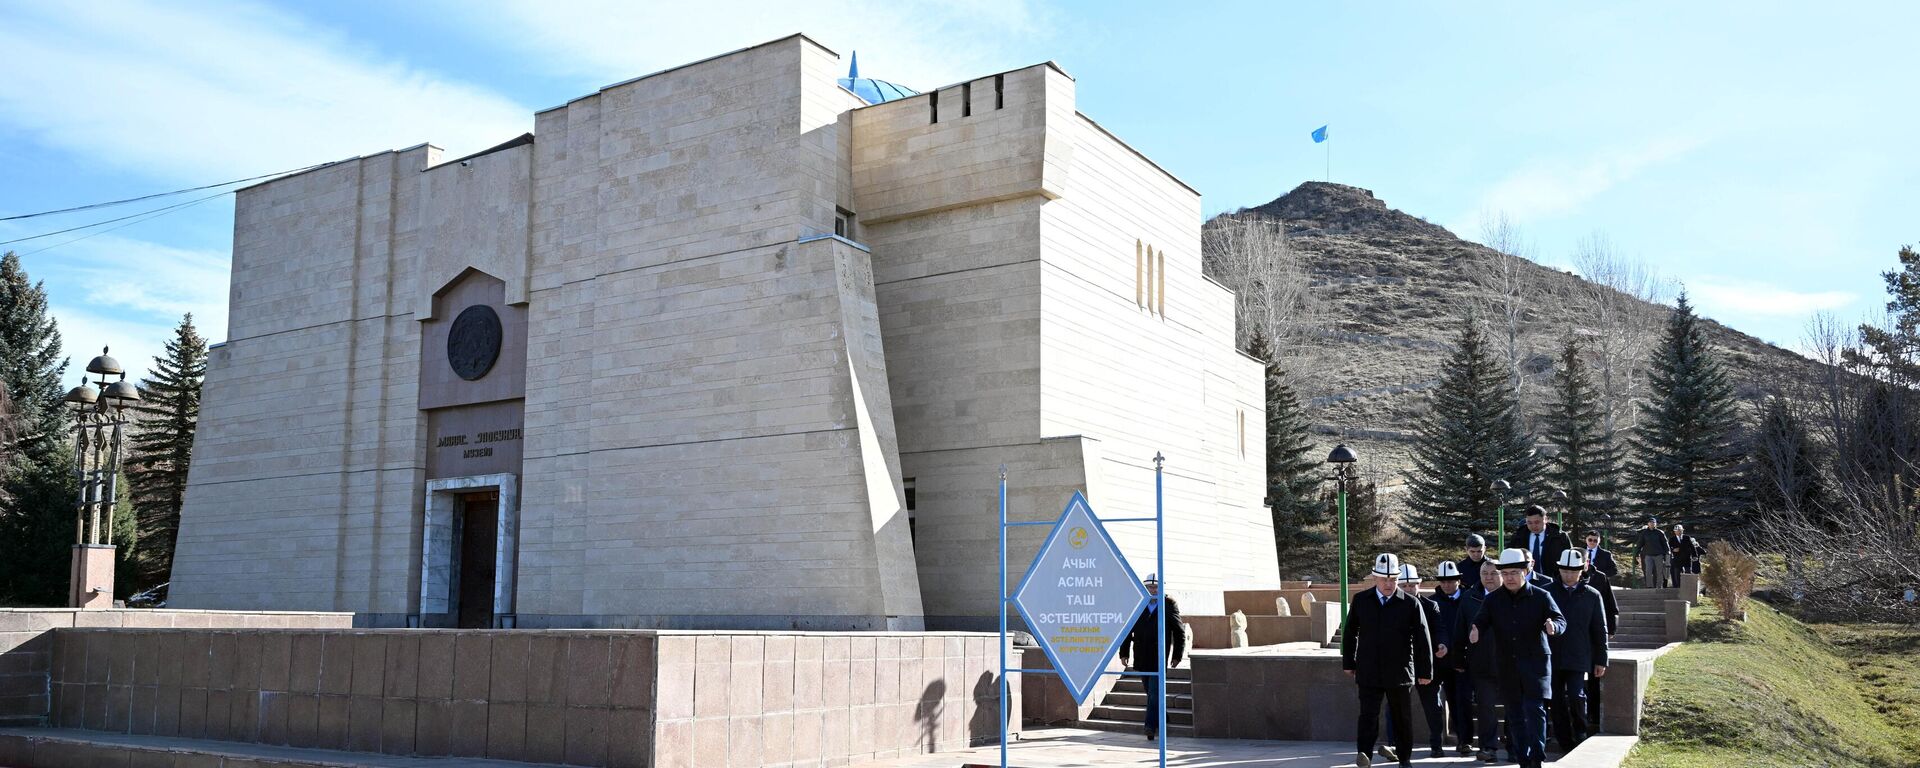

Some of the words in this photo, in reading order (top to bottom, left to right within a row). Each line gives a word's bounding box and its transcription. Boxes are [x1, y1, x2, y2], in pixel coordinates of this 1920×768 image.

[1062, 557, 1097, 569] АЧЫК
[1057, 576, 1103, 588] АСМАН
[1066, 594, 1095, 606] ТАШ
